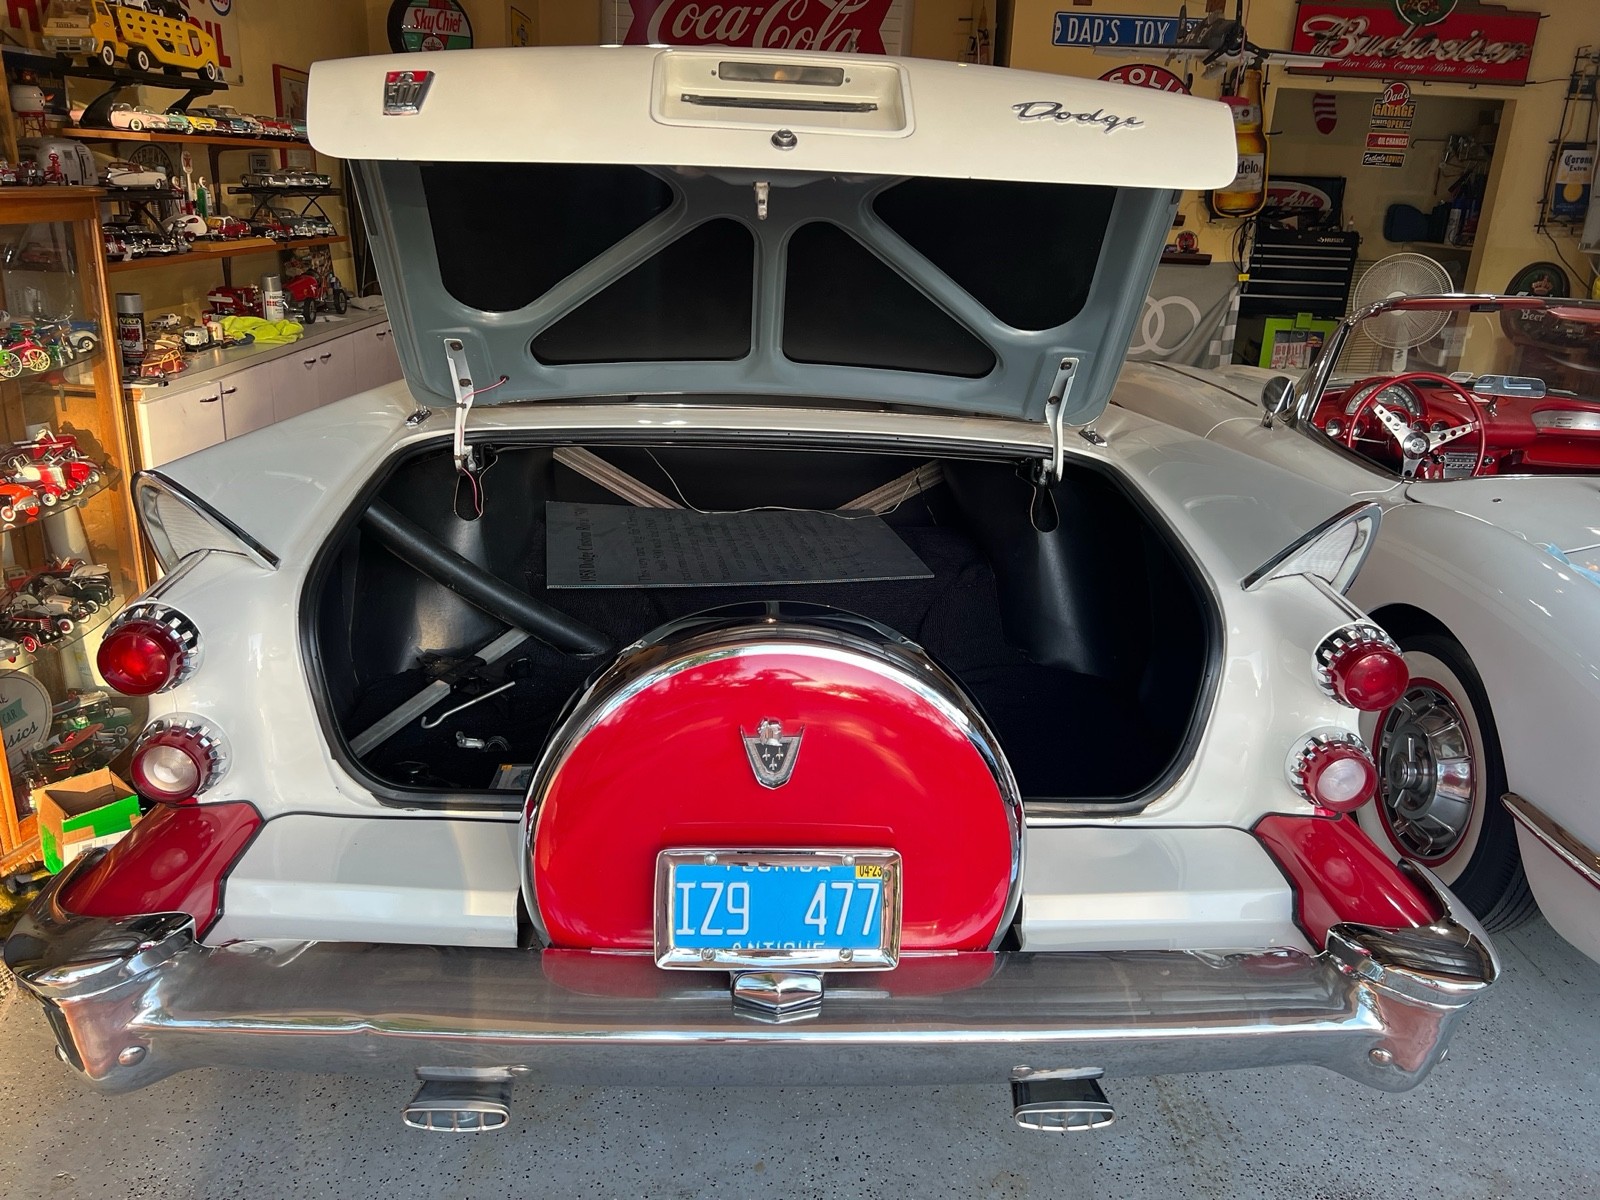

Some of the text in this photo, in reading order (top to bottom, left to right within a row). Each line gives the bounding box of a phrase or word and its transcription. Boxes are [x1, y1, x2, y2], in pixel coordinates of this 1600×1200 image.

[54, 21, 79, 29] Tonka
[413, 8, 463, 33] Sky Chief
[646, 0, 861, 53] Coca-Cola
[1067, 18, 1120, 44] DAD'S
[1135, 20, 1170, 45] TOY
[1302, 13, 1529, 64] Budweiser
[1338, 59, 1360, 68] Beer
[1366, 60, 1387, 69] Bier
[1393, 61, 1425, 74] Cerveza
[1430, 63, 1456, 73] Birra
[387, 82, 421, 105] 500
[1383, 88, 1410, 103] Dad's
[1011, 101, 1145, 135] Dodge
[1374, 104, 1414, 117] GARAGE
[1387, 120, 1404, 129] OPEN
[1377, 136, 1386, 145] OIL
[1386, 137, 1408, 146] CHANGES
[1564, 154, 1593, 166] Corona
[1238, 161, 1259, 175] delo
[1520, 308, 1545, 322] Beer
[578, 551, 600, 569] Dodge
[2, 709, 18, 724] CAR
[858, 865, 883, 878] 04-23
[676, 882, 880, 936] IZ9 477
